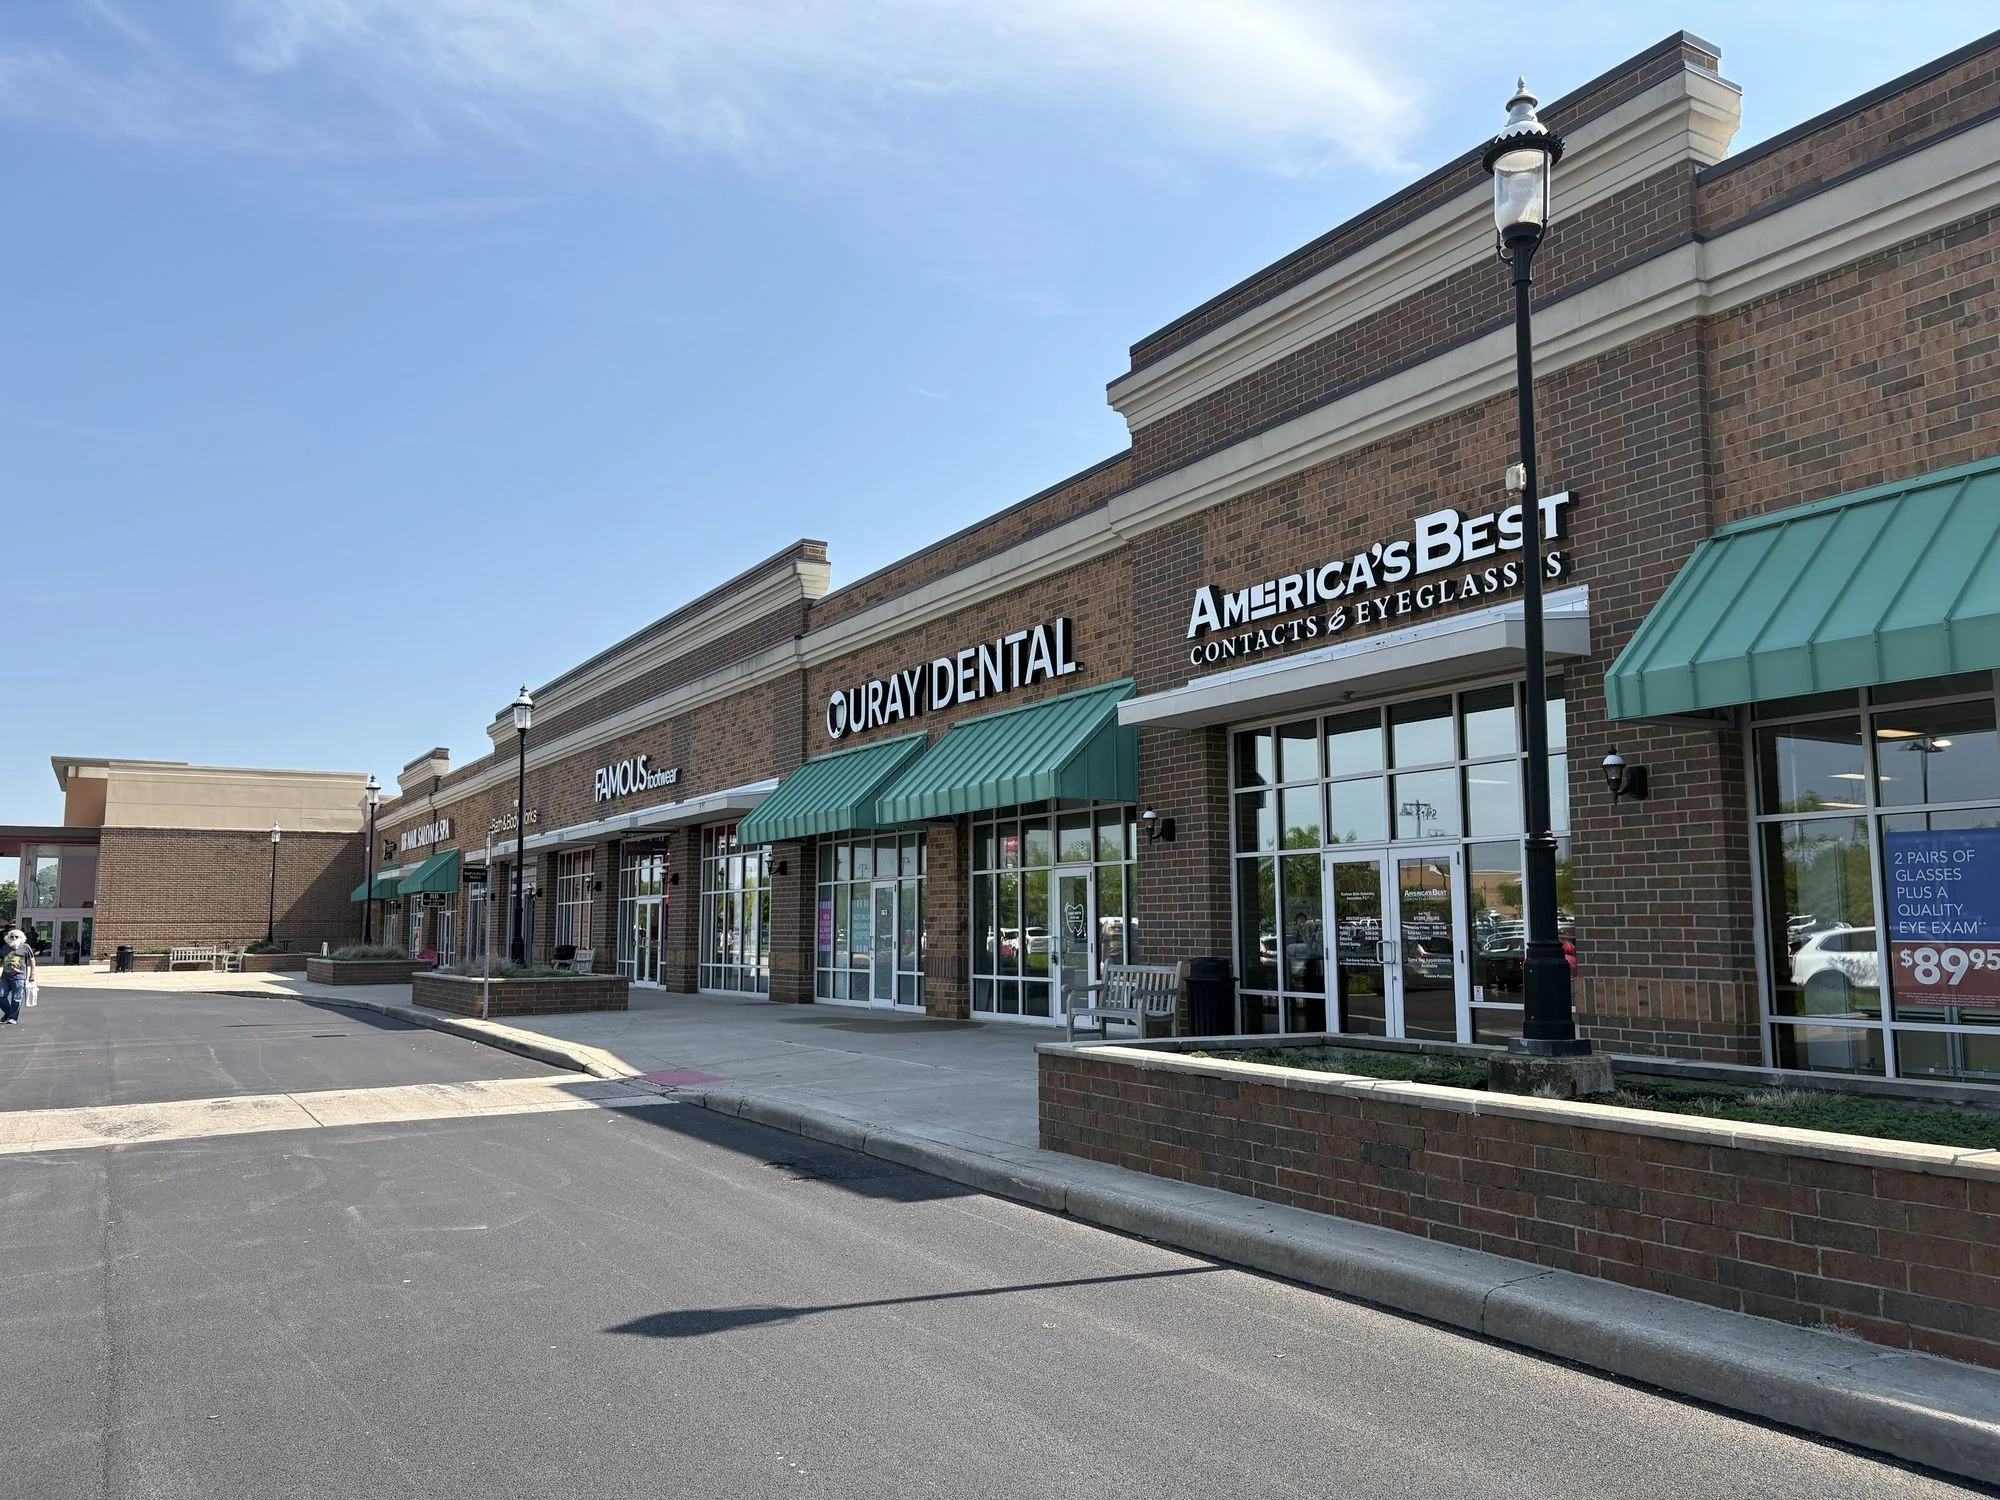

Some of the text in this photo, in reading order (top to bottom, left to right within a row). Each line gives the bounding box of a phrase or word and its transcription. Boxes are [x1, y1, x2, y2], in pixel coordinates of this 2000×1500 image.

[1187, 491, 1571, 638] AMERICA'S BEST
[1190, 551, 1562, 666] CONTACTS & EYEGLASSS
[827, 617, 1076, 739] OURAY DENTAL
[595, 754, 679, 803] FAMOUS footwear
[417, 823, 435, 847] SALON
[439, 818, 450, 841] SPA
[1894, 850, 1975, 865] 2 PAIRS OF
[1895, 868, 1962, 882] GLASSES
[1897, 886, 1948, 899] PLUS A
[1898, 903, 1963, 917] QUALITY
[1899, 921, 1927, 934] EYE
